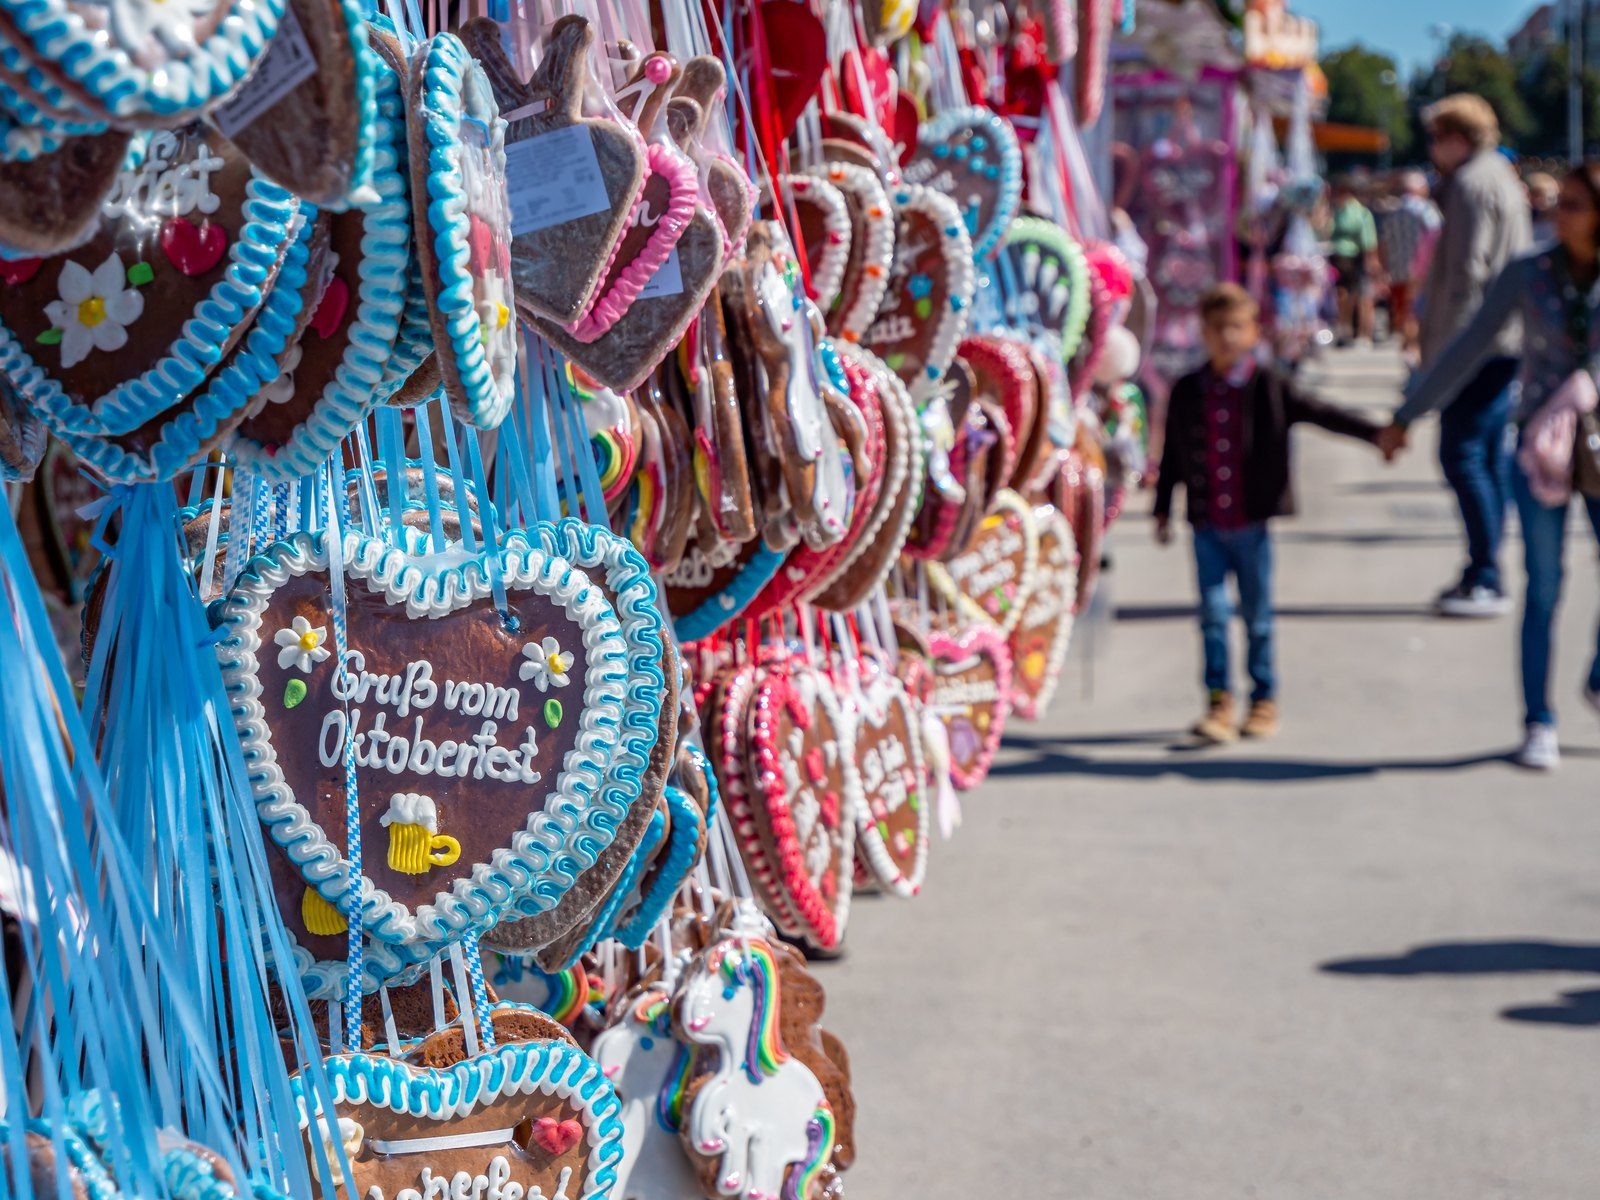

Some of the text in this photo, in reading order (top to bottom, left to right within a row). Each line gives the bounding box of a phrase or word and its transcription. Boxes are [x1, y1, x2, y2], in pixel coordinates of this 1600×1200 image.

[331, 650, 520, 721] Gruß vom
[319, 709, 542, 784] Oktoberfest
